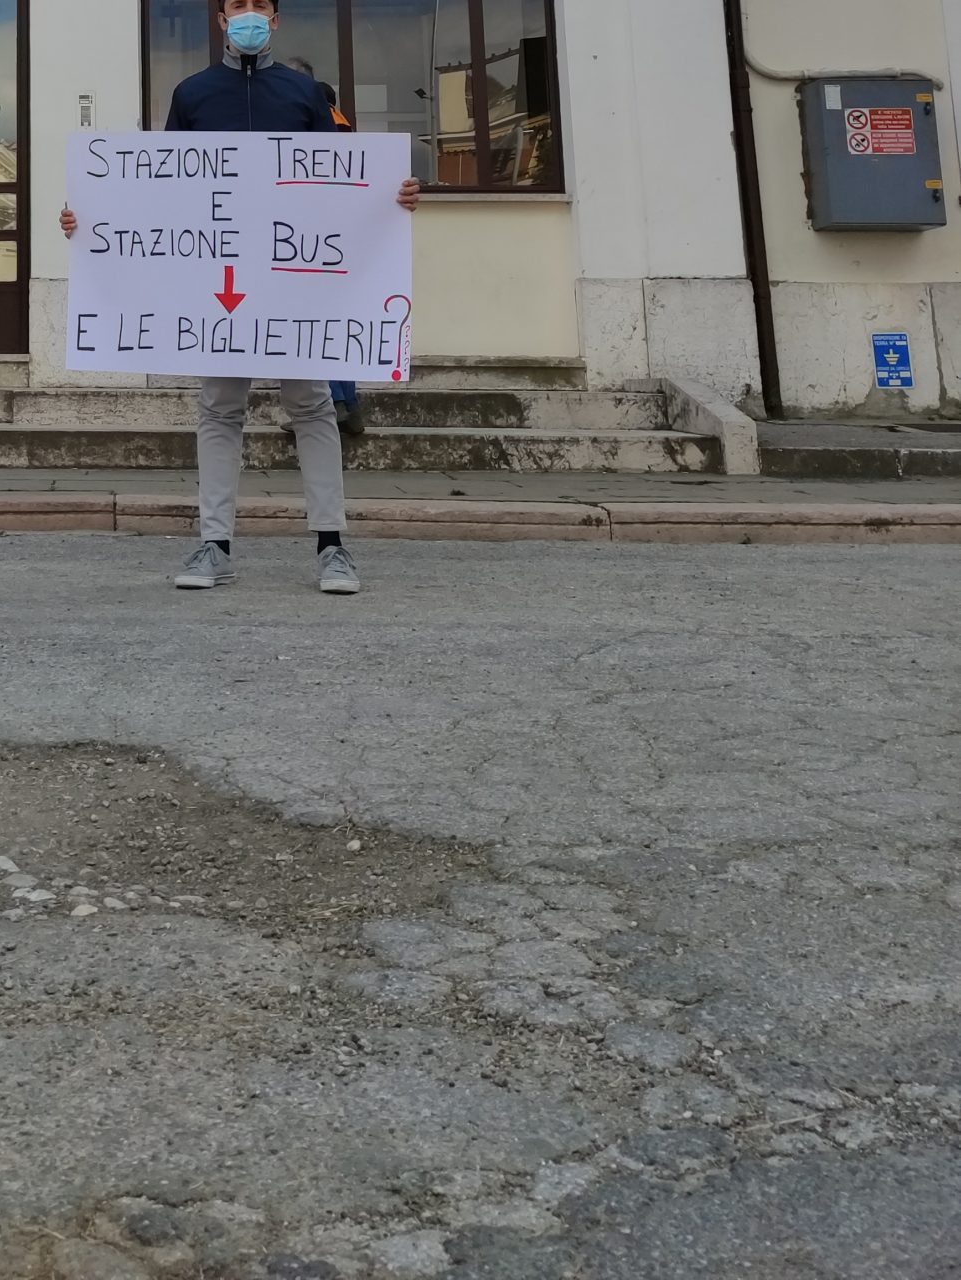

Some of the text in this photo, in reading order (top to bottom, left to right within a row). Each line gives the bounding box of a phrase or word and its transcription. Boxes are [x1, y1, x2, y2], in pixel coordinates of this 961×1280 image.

[86, 136, 366, 181] STAZIONE TRENI
[212, 190, 233, 222] E
[89, 220, 344, 266] STAZIONE BUS
[76, 313, 98, 352] E
[117, 313, 155, 352] LE
